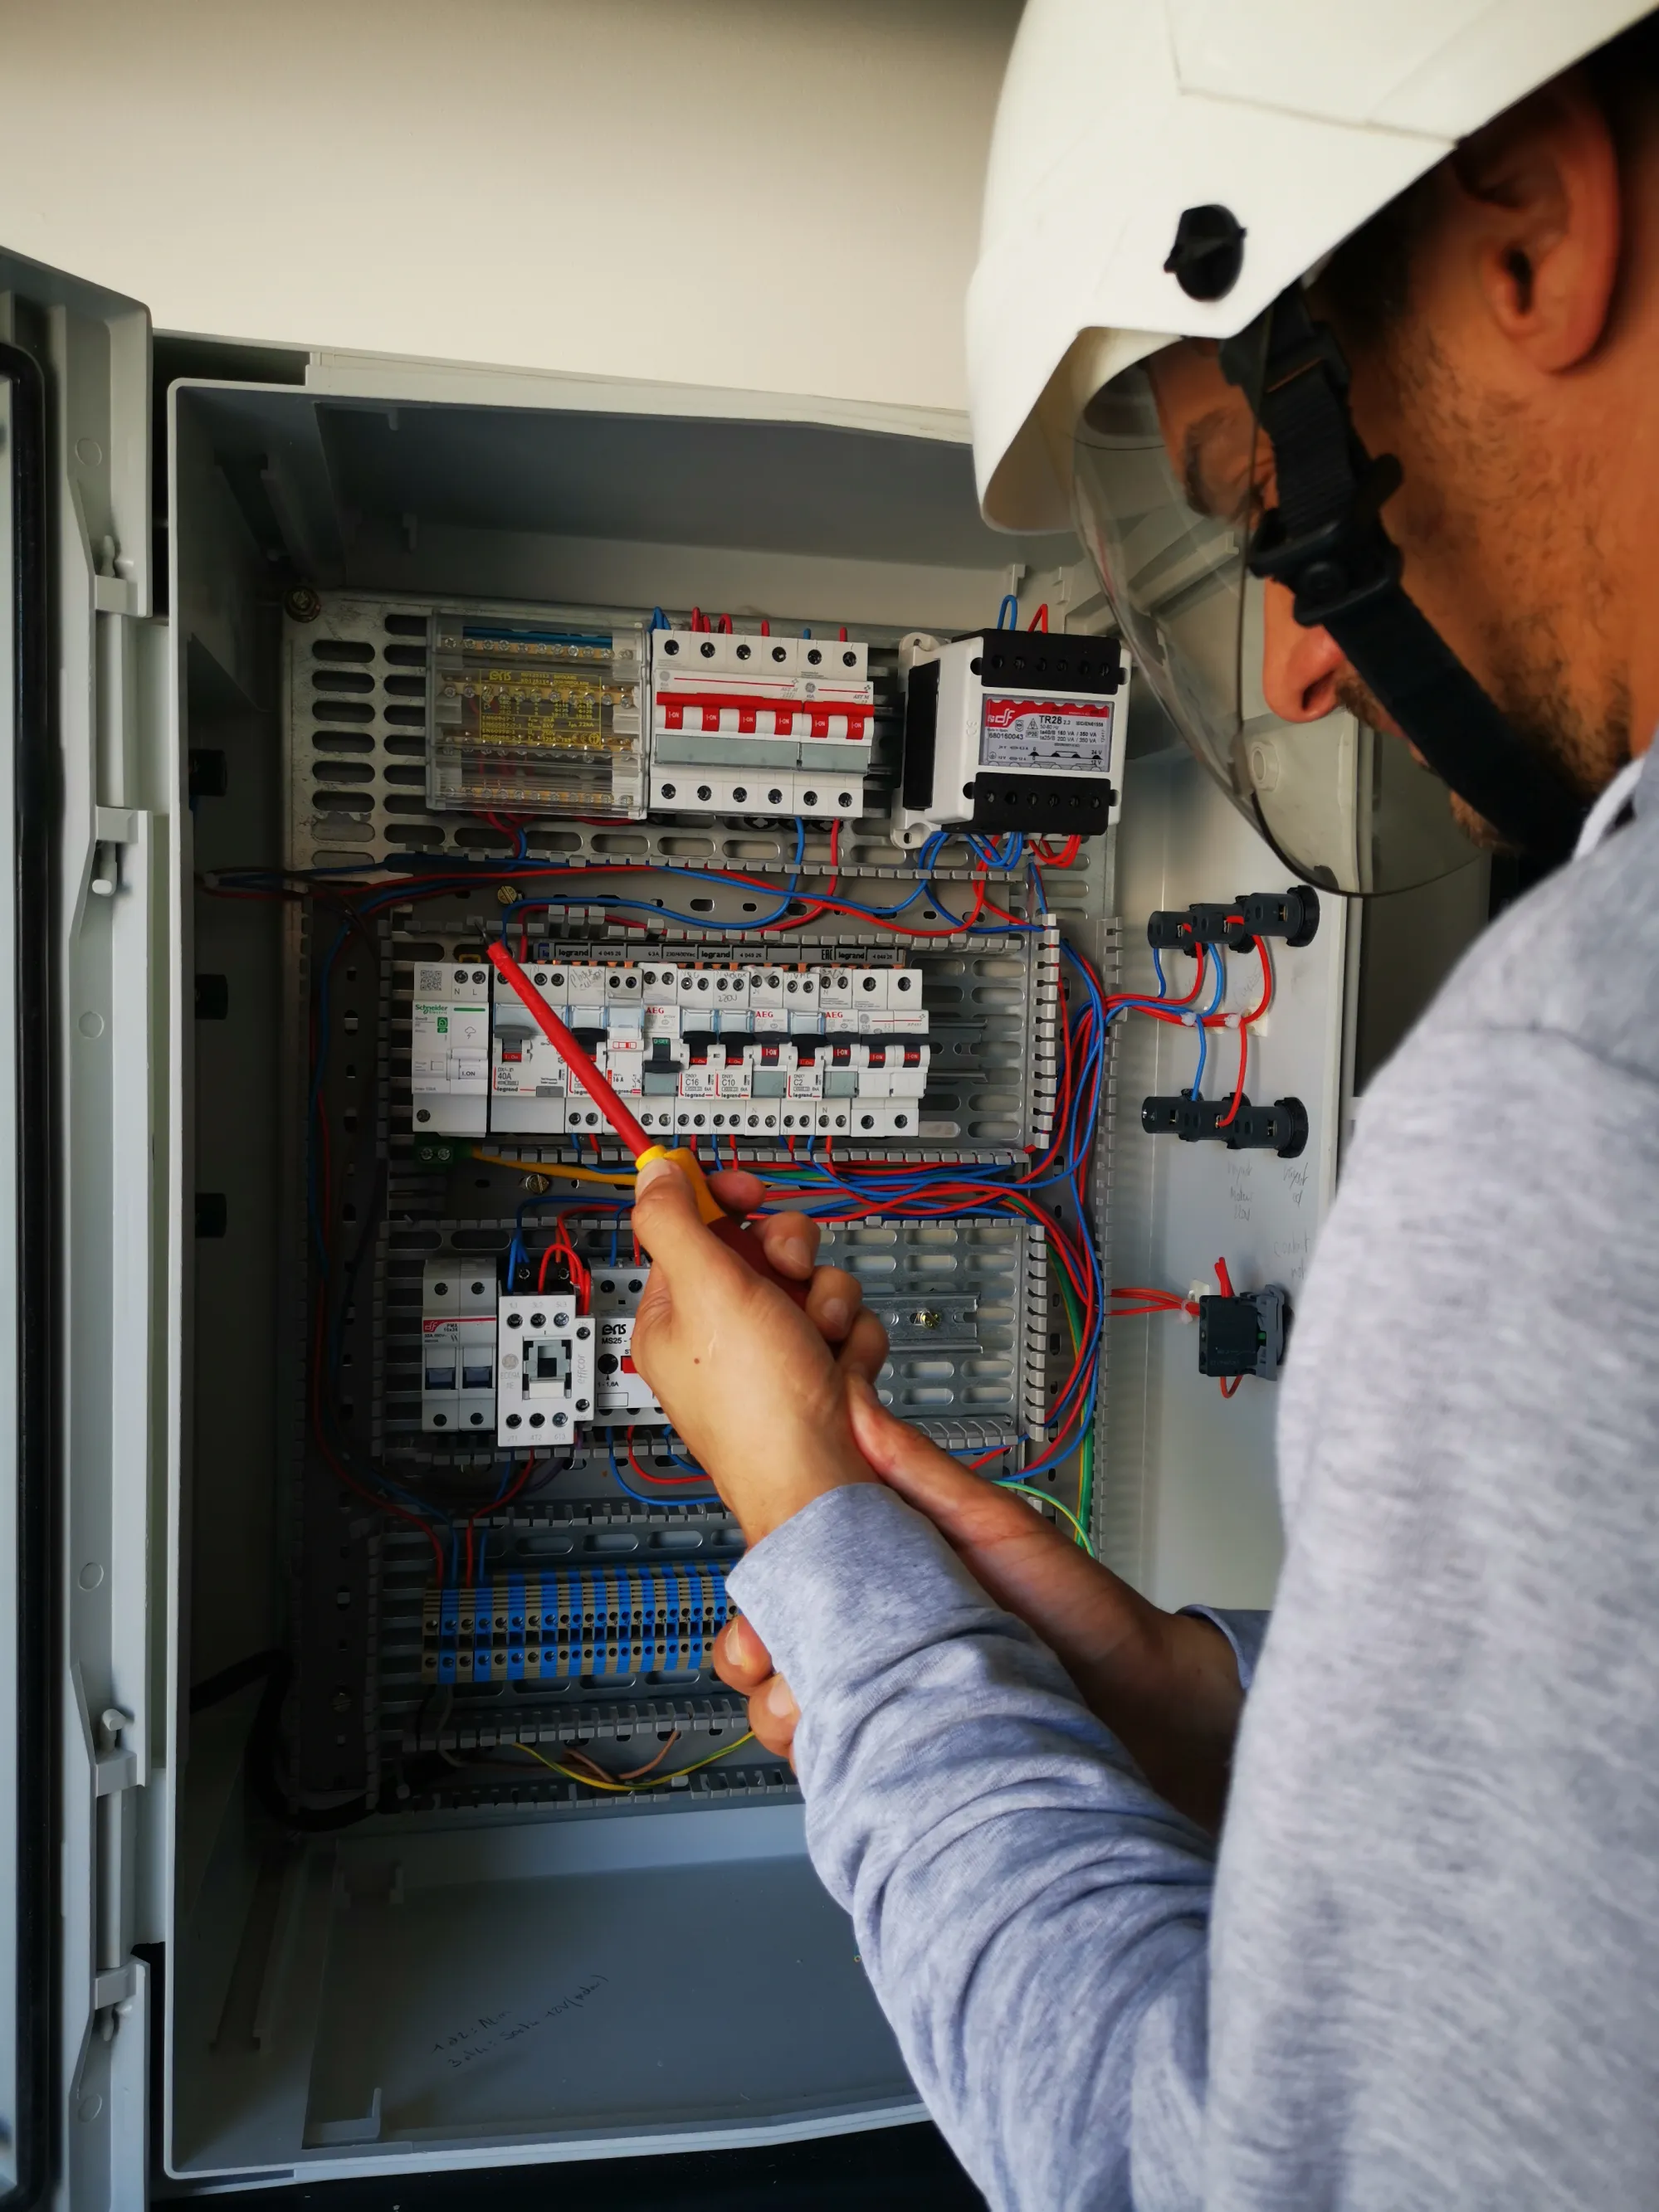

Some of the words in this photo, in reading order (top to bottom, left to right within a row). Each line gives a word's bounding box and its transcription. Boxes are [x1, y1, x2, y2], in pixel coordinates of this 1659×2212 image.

[1039, 715, 1062, 724] TR28
[559, 949, 589, 957] legrand
[838, 952, 865, 960] legrand
